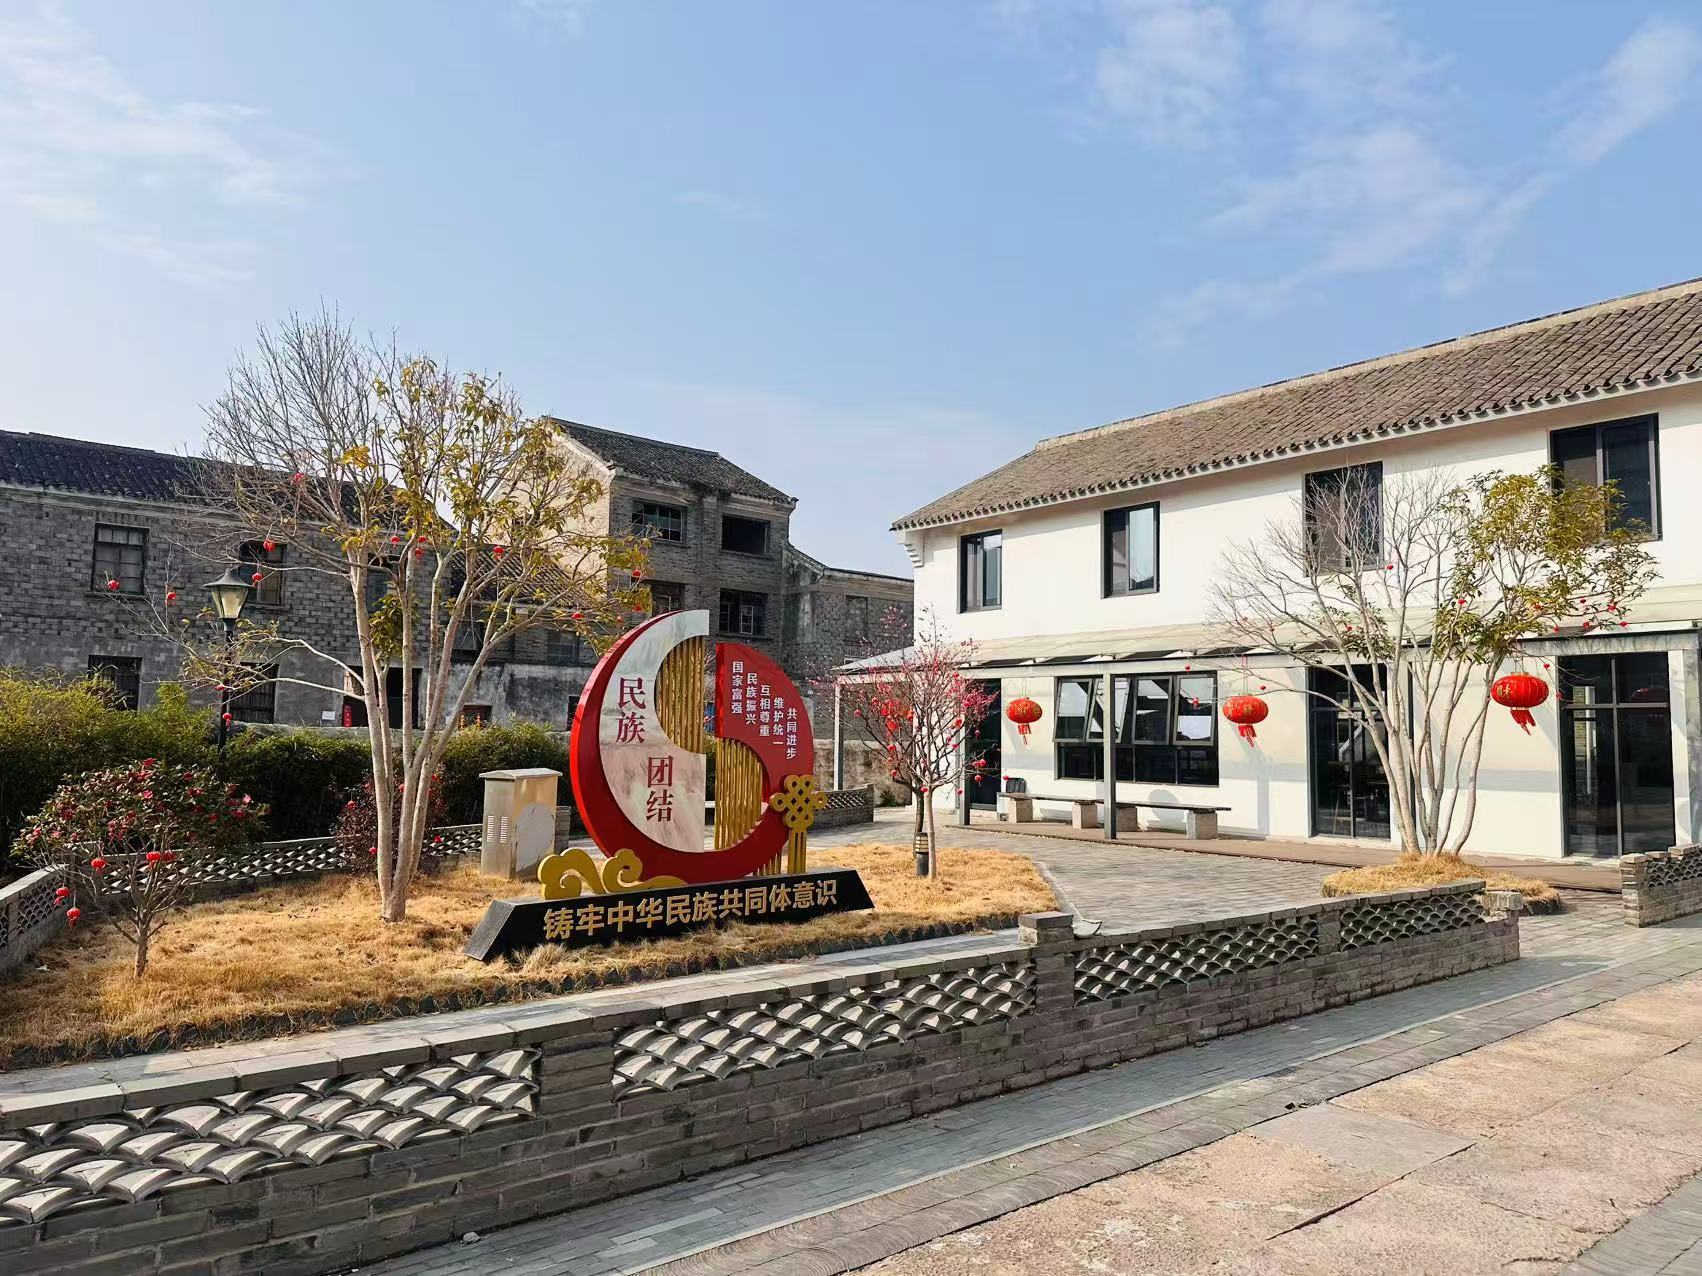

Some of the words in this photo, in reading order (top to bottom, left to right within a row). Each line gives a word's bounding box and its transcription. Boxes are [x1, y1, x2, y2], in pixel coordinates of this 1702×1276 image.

[615, 677, 647, 744] 民族
[731, 661, 744, 714] 国家富强
[745, 672, 758, 725] 民族振兴
[759, 684, 772, 737] 互相尊重
[773, 696, 785, 745] 维护统一
[786, 707, 798, 760] 共同进步
[646, 755, 674, 822] 团结
[542, 879, 838, 941] 铸牢中华民族共同体意识
